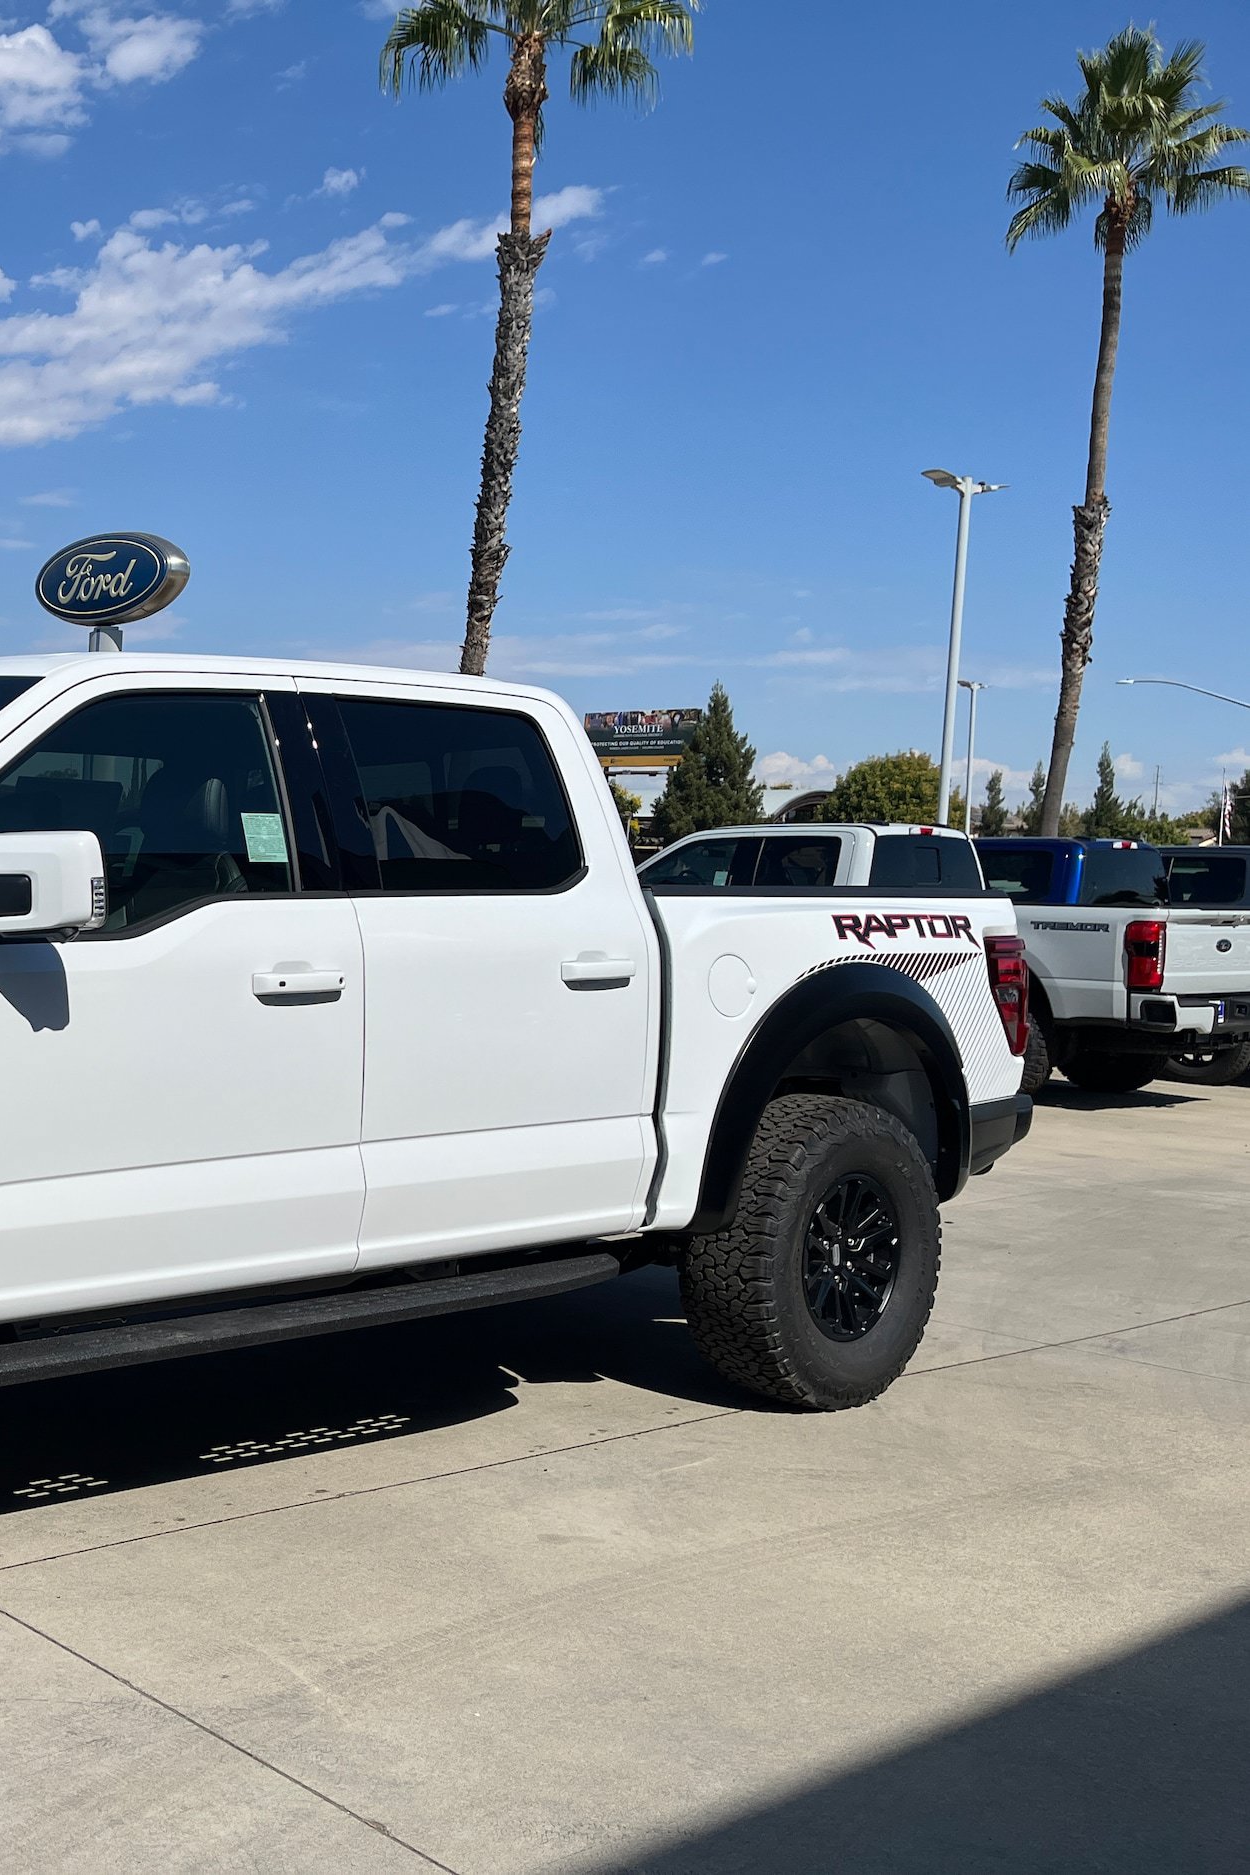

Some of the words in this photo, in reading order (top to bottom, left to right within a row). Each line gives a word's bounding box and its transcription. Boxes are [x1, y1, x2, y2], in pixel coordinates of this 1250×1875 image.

[57, 550, 137, 604] Ford
[614, 724, 663, 734] YOSEMITE
[831, 914, 982, 950] RAPTOR
[1030, 921, 1110, 932] TREMOR
